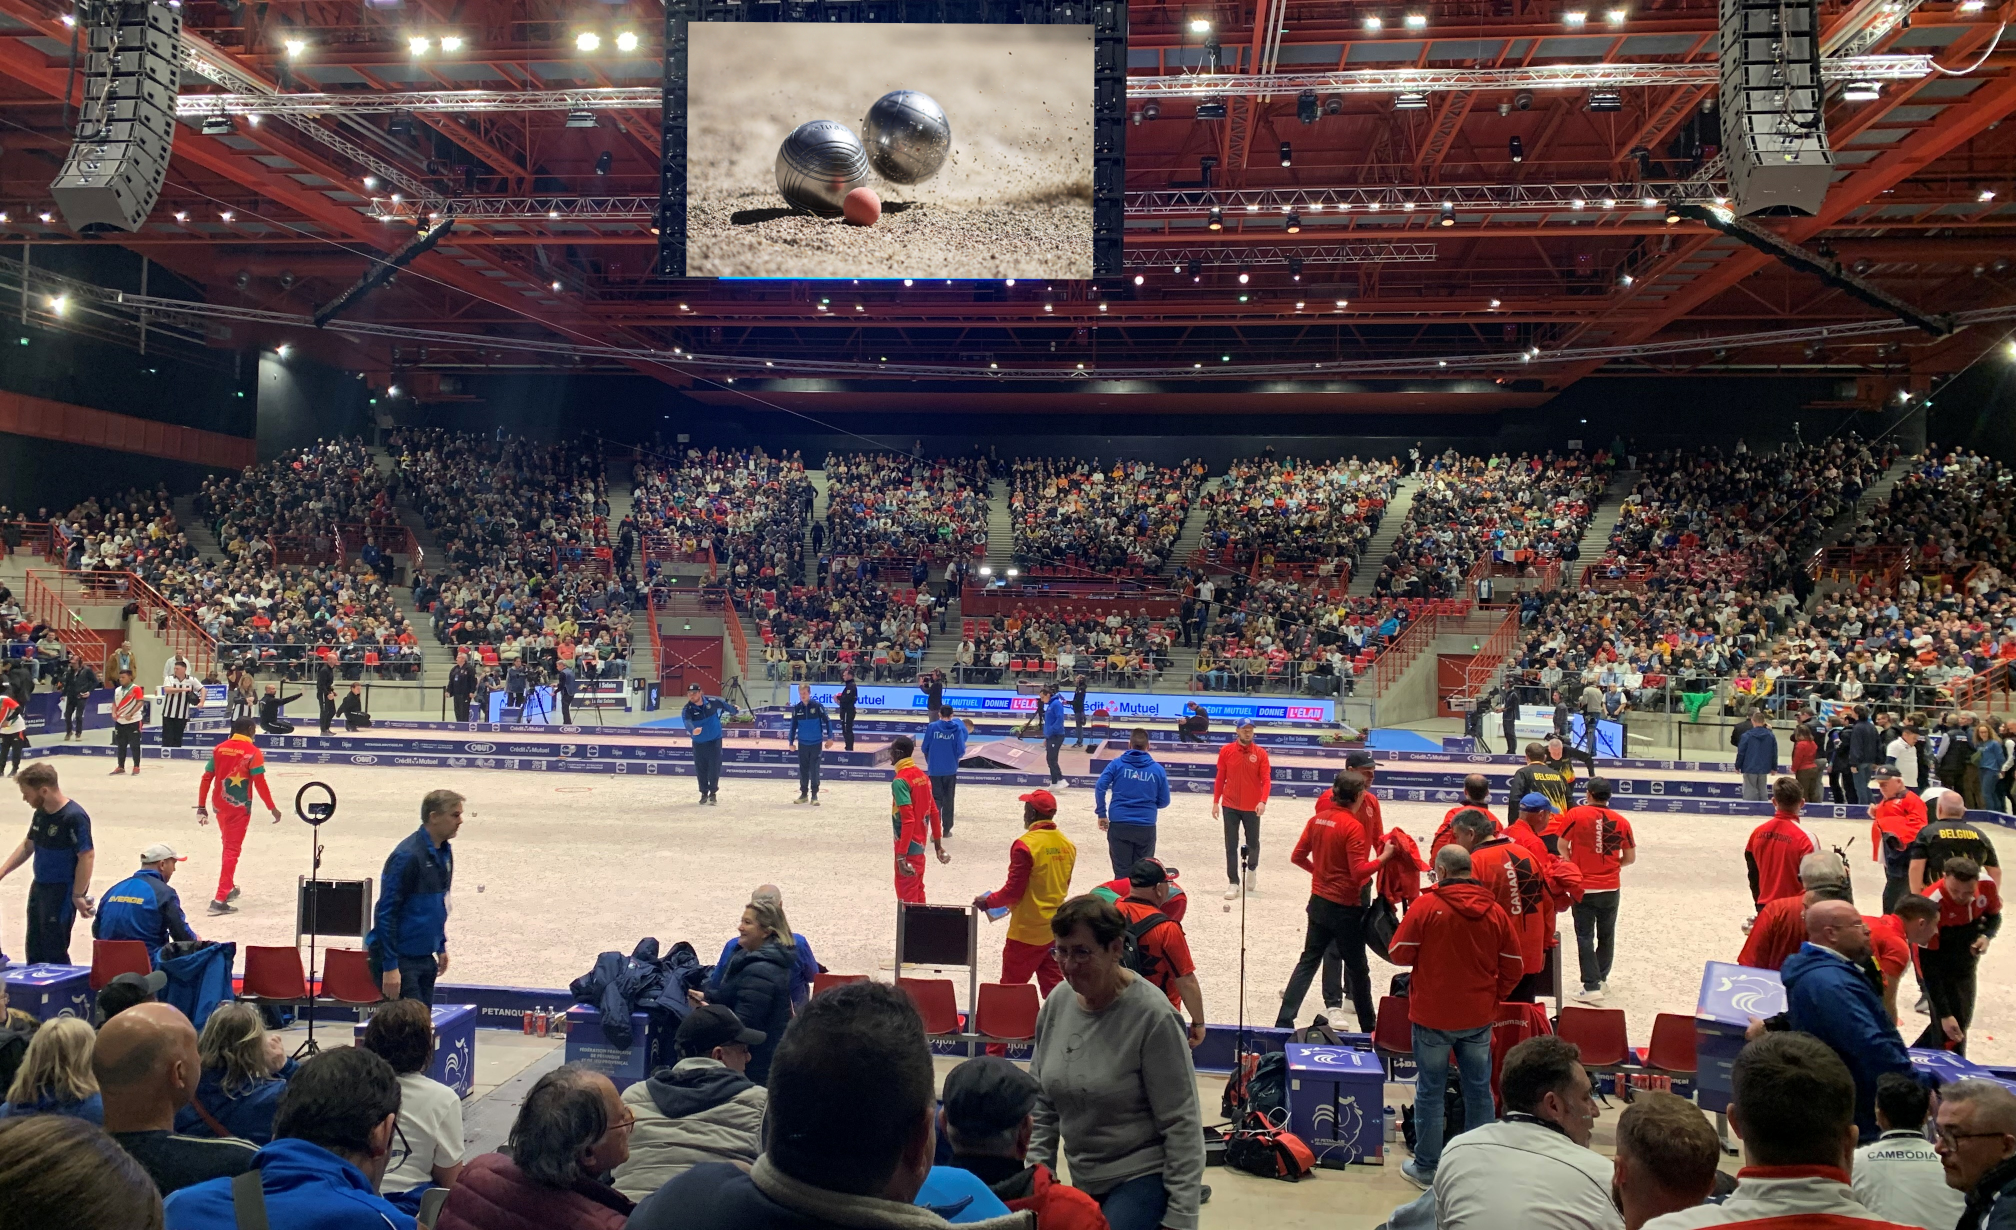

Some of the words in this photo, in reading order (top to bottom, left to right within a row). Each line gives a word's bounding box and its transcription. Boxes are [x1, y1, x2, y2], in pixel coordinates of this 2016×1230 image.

[857, 694, 885, 706] utuel
[915, 697, 925, 705] LE
[951, 698, 979, 707] MUTUEL
[984, 699, 1010, 708] DONNE
[1013, 698, 1038, 709] L'ÉLA
[1119, 702, 1159, 714] Mutuel
[1223, 707, 1253, 716] MUTUEL
[1258, 708, 1285, 717] DONNE
[1289, 708, 1323, 719] L'ÉLAN
[471, 744, 490, 752] OBUT
[1123, 768, 1156, 783] ITALIA
[1533, 772, 1561, 781] BELGIUM
[1595, 818, 1603, 854] CANADA
[1939, 829, 1979, 840] BELGIUM
[1503, 860, 1522, 915] CANADA
[1867, 1150, 1938, 1160] CAMBODIA
